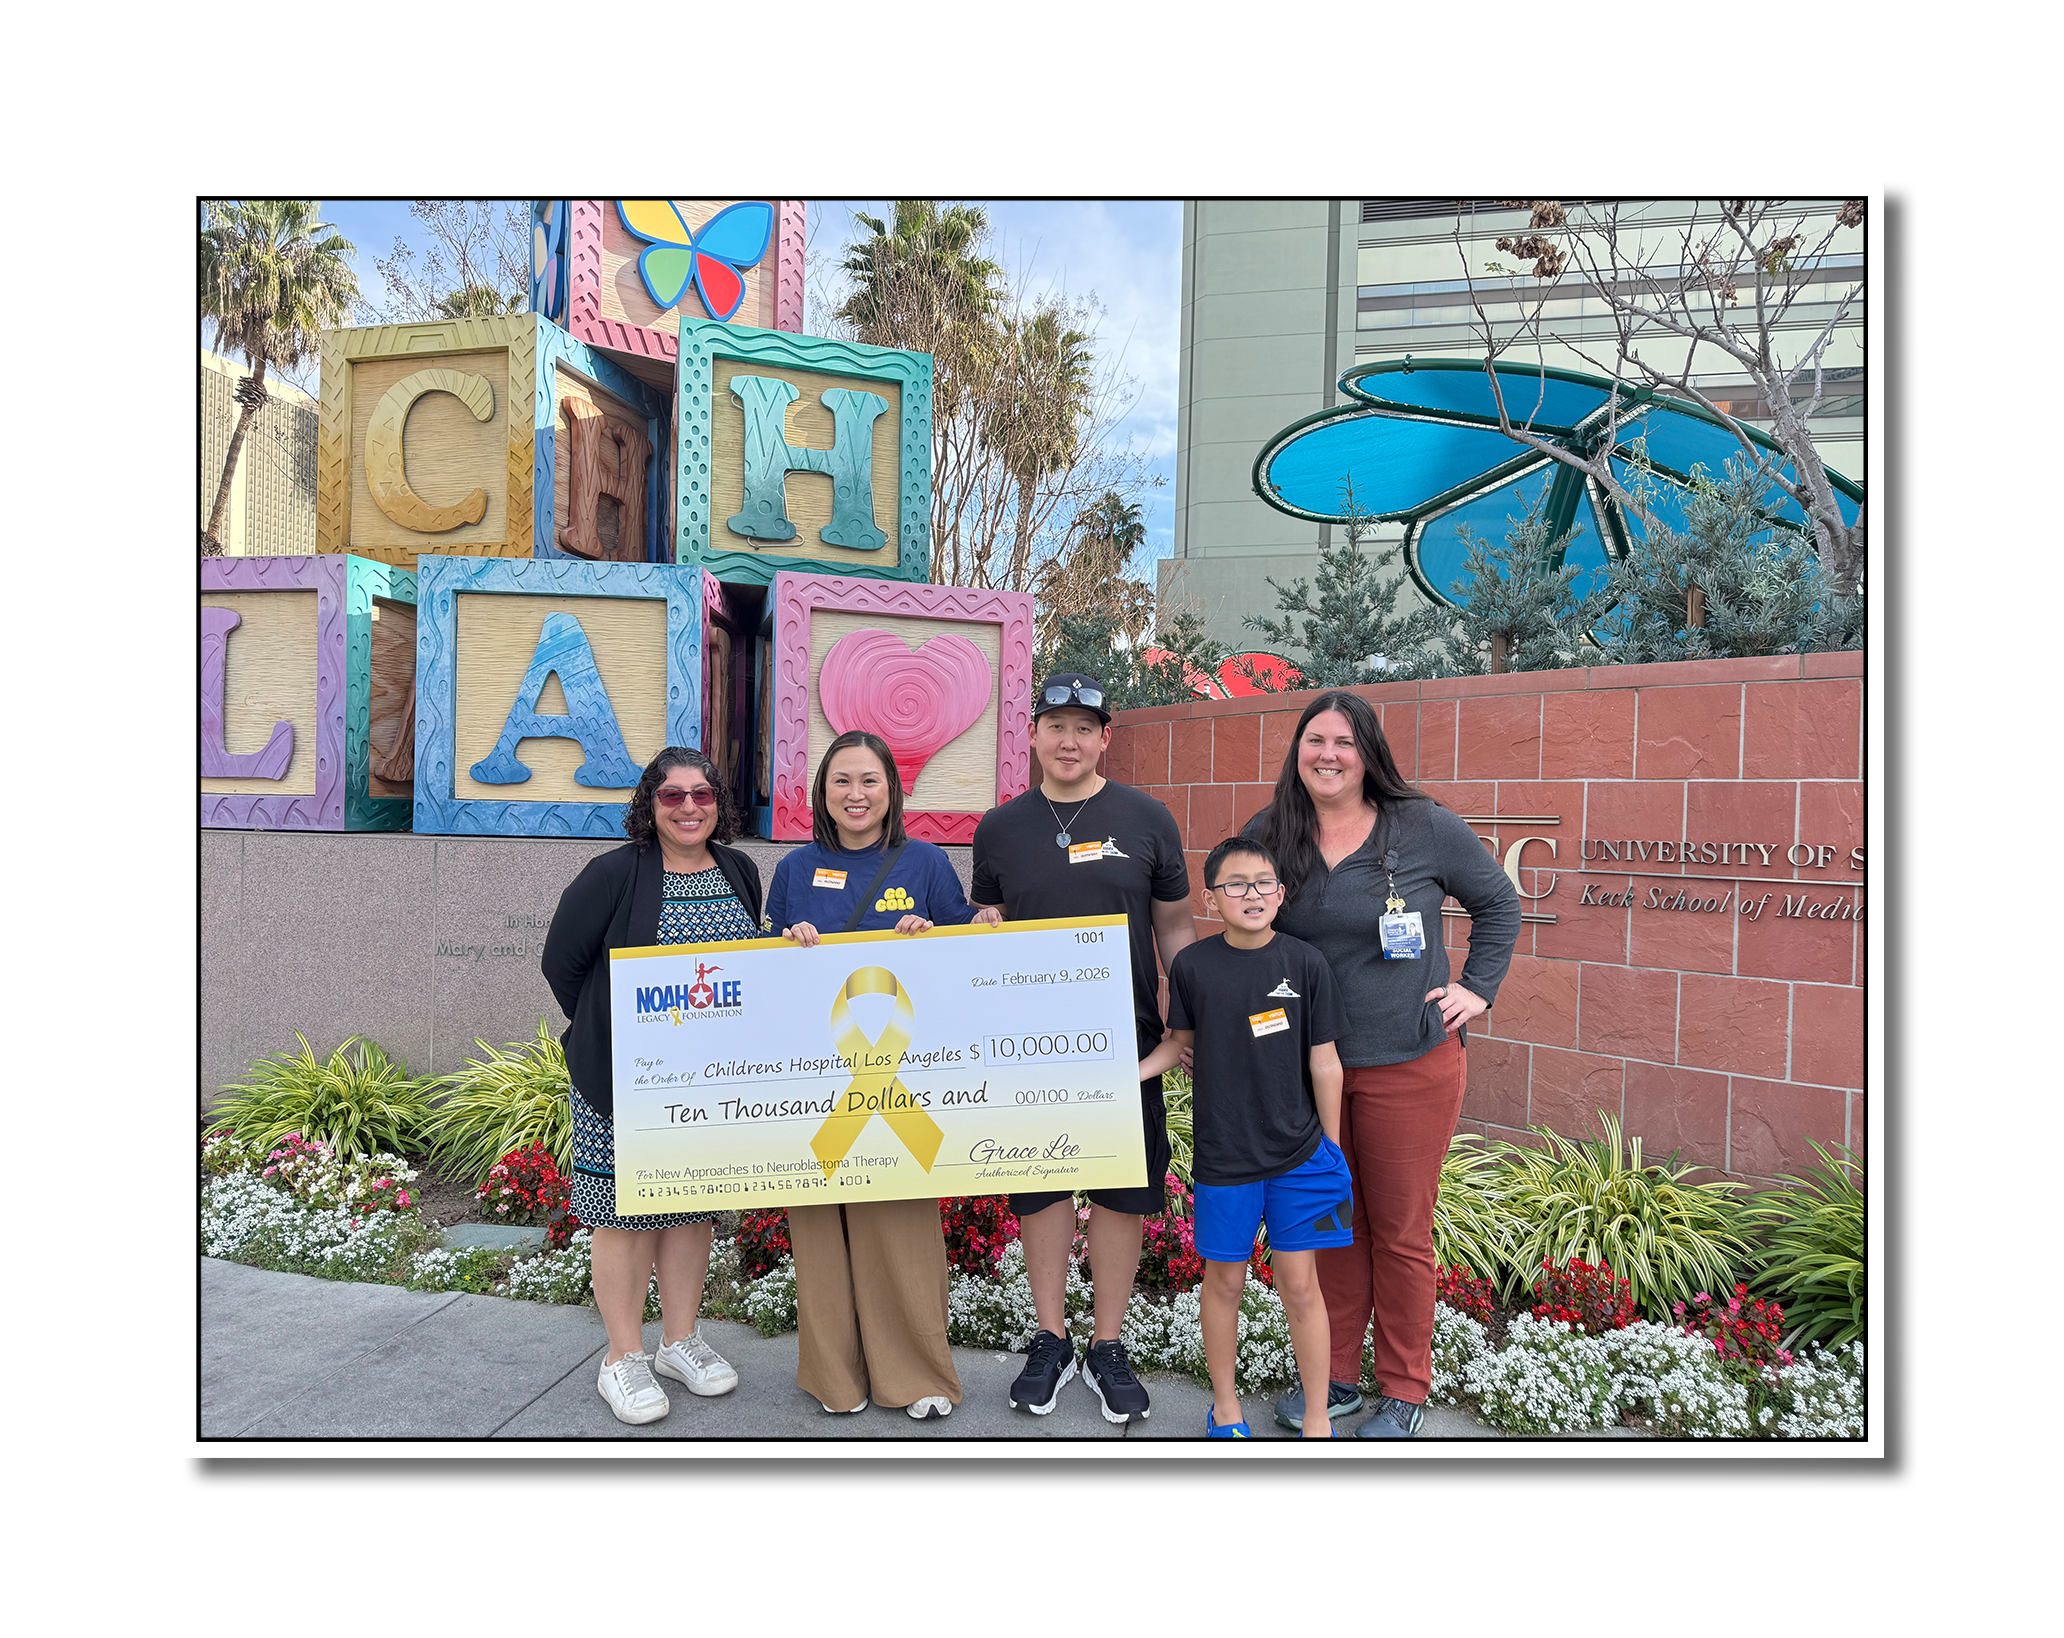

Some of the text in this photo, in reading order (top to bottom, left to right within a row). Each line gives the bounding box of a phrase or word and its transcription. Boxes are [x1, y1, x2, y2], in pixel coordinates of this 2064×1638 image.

[365, 368, 494, 533] C
[727, 374, 890, 551] H
[200, 606, 294, 781] L
[469, 611, 645, 789] A
[1579, 838, 1778, 866] UNIVERSITY
[1787, 843, 1837, 868] OF
[875, 897, 915, 912] GOLD
[884, 887, 907, 900] GO
[1579, 883, 1635, 908] Keck
[1643, 886, 1733, 913] School
[1740, 893, 1772, 922] of
[506, 915, 519, 928] In
[435, 939, 485, 962] Mary
[491, 937, 527, 957] and
[1074, 931, 1105, 944] 1001
[971, 967, 1110, 988] Date February 9, 2026
[636, 980, 742, 1014] NOAH LEE
[637, 1009, 743, 1024] LEGACY FOUNDATION
[634, 1057, 664, 1071] Pay to
[703, 1032, 1108, 1079] Childrens Hospital Los Angeles $ 10,000.00
[634, 1071, 697, 1086] the Order Of
[664, 1080, 1115, 1123] Ten Thousand Dollars and 00/100 Dollars
[969, 1133, 1081, 1165] Grace Lee
[636, 1155, 899, 1181] For New Approaches to Neuroblastoma Therapy
[840, 1175, 871, 1186] 1001
[974, 1164, 1079, 1180] Authorized Signature
